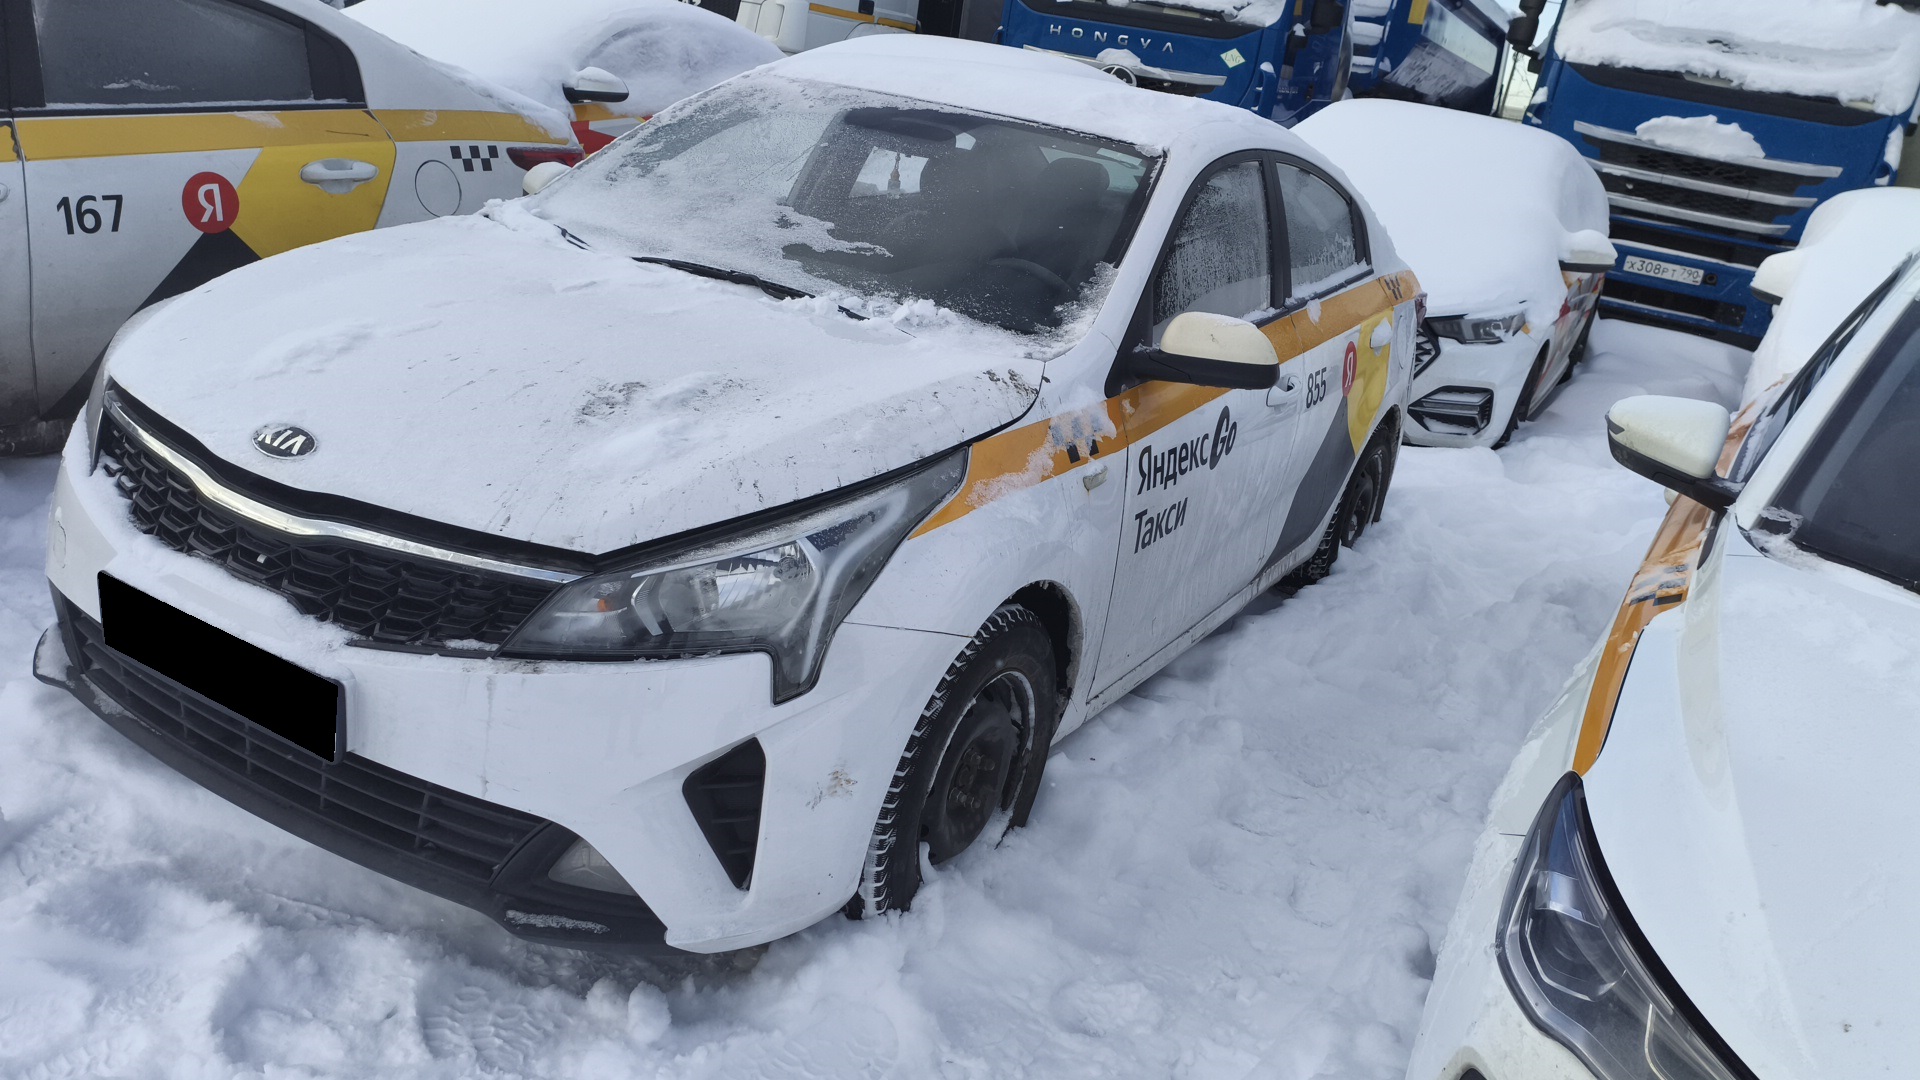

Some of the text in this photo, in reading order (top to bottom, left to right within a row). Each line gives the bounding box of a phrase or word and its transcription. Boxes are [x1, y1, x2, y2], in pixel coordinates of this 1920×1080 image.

[1224, 52, 1241, 64] LNG
[56, 194, 124, 236] 167
[197, 183, 224, 223] Я
[1305, 366, 1327, 409] 855
[1137, 405, 1238, 496] Яндекс Go
[1133, 496, 1189, 555] Такси
